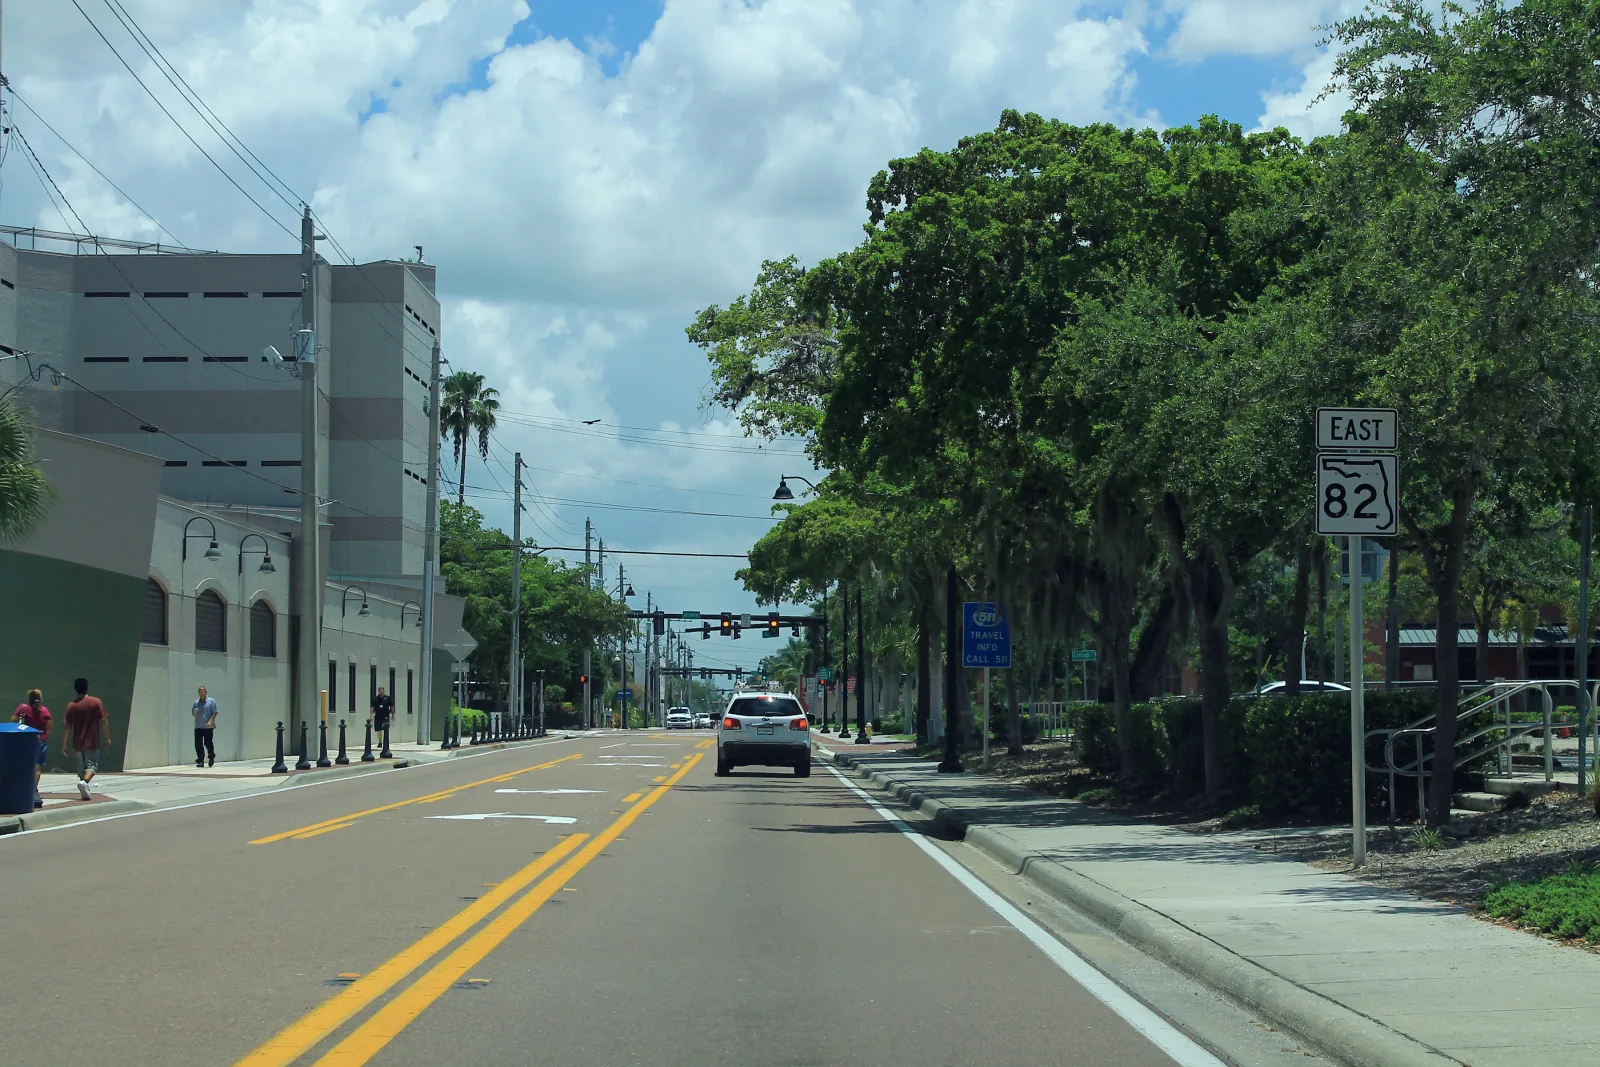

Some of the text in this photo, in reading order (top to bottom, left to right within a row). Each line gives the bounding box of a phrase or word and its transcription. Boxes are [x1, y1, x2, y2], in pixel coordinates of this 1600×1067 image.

[1331, 417, 1383, 441] EAST
[1323, 483, 1377, 519] 82
[979, 612, 996, 622] 511
[970, 631, 1005, 640] TRAVEL
[977, 643, 998, 652] INFO
[966, 654, 1008, 664] CALL 511
